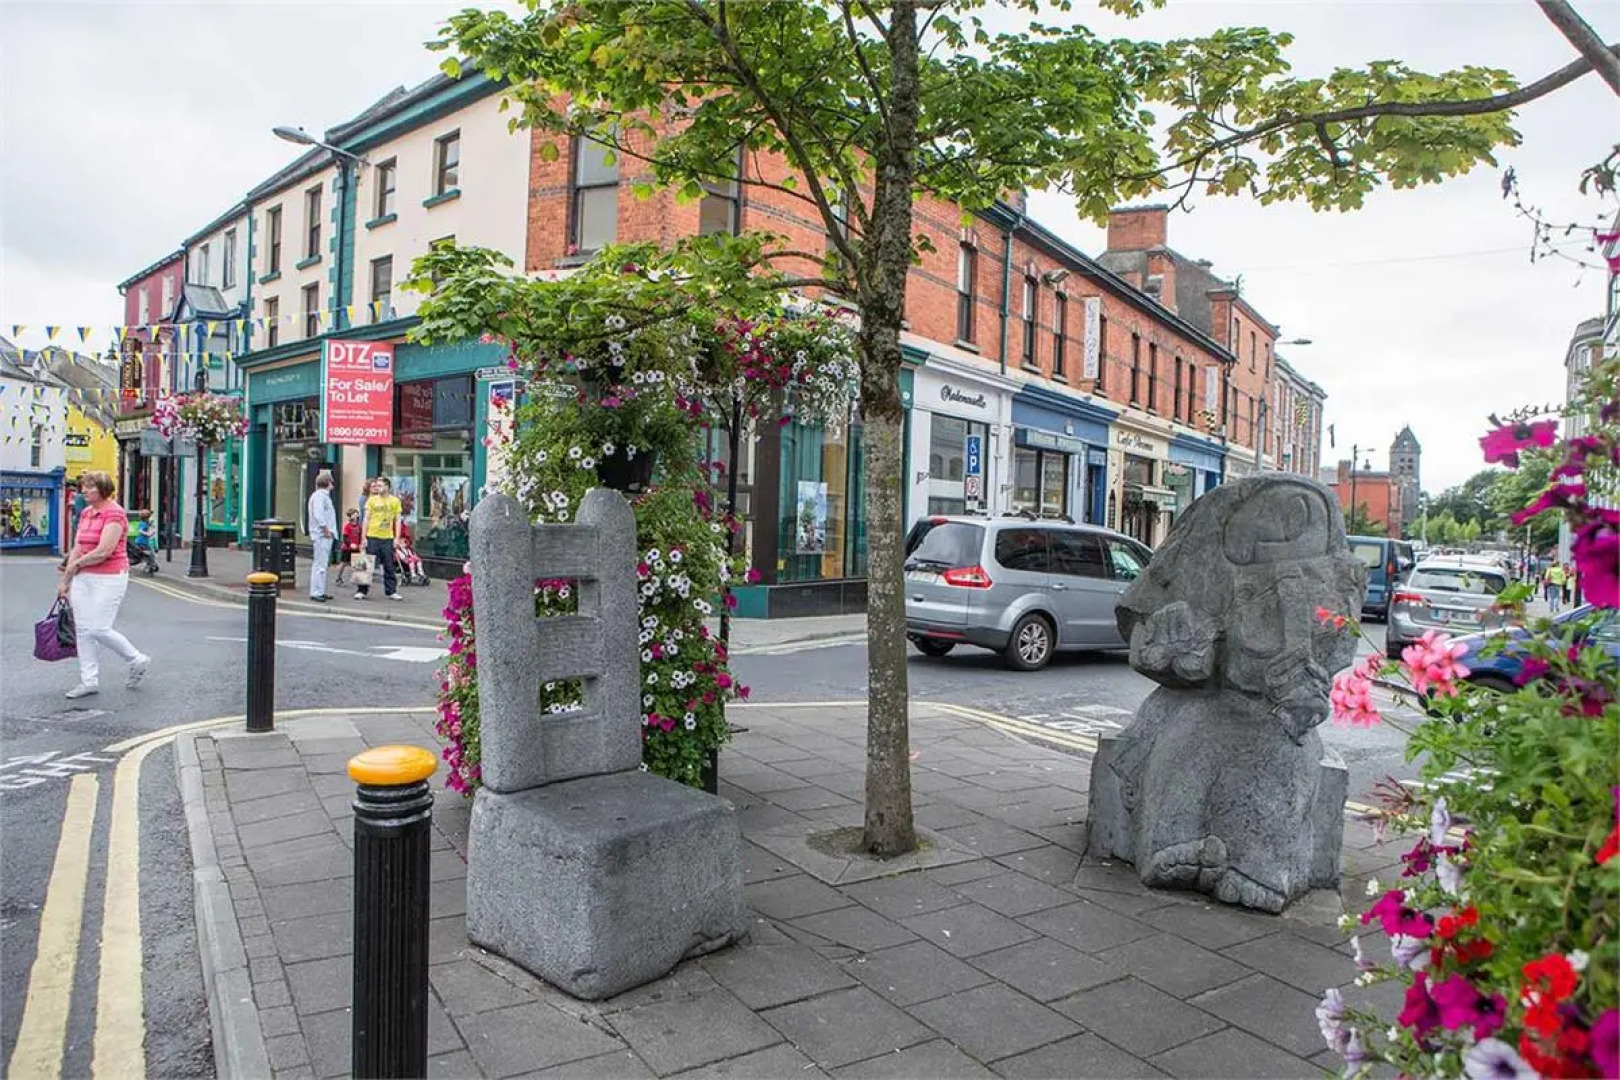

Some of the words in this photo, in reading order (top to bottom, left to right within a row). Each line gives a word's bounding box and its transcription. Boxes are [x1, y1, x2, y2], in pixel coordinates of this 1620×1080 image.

[330, 343, 371, 363] DTZ
[329, 378, 352, 390] For
[354, 378, 390, 391] Sale/
[329, 390, 345, 402] To
[347, 391, 369, 403] Let
[970, 455, 977, 472] P
